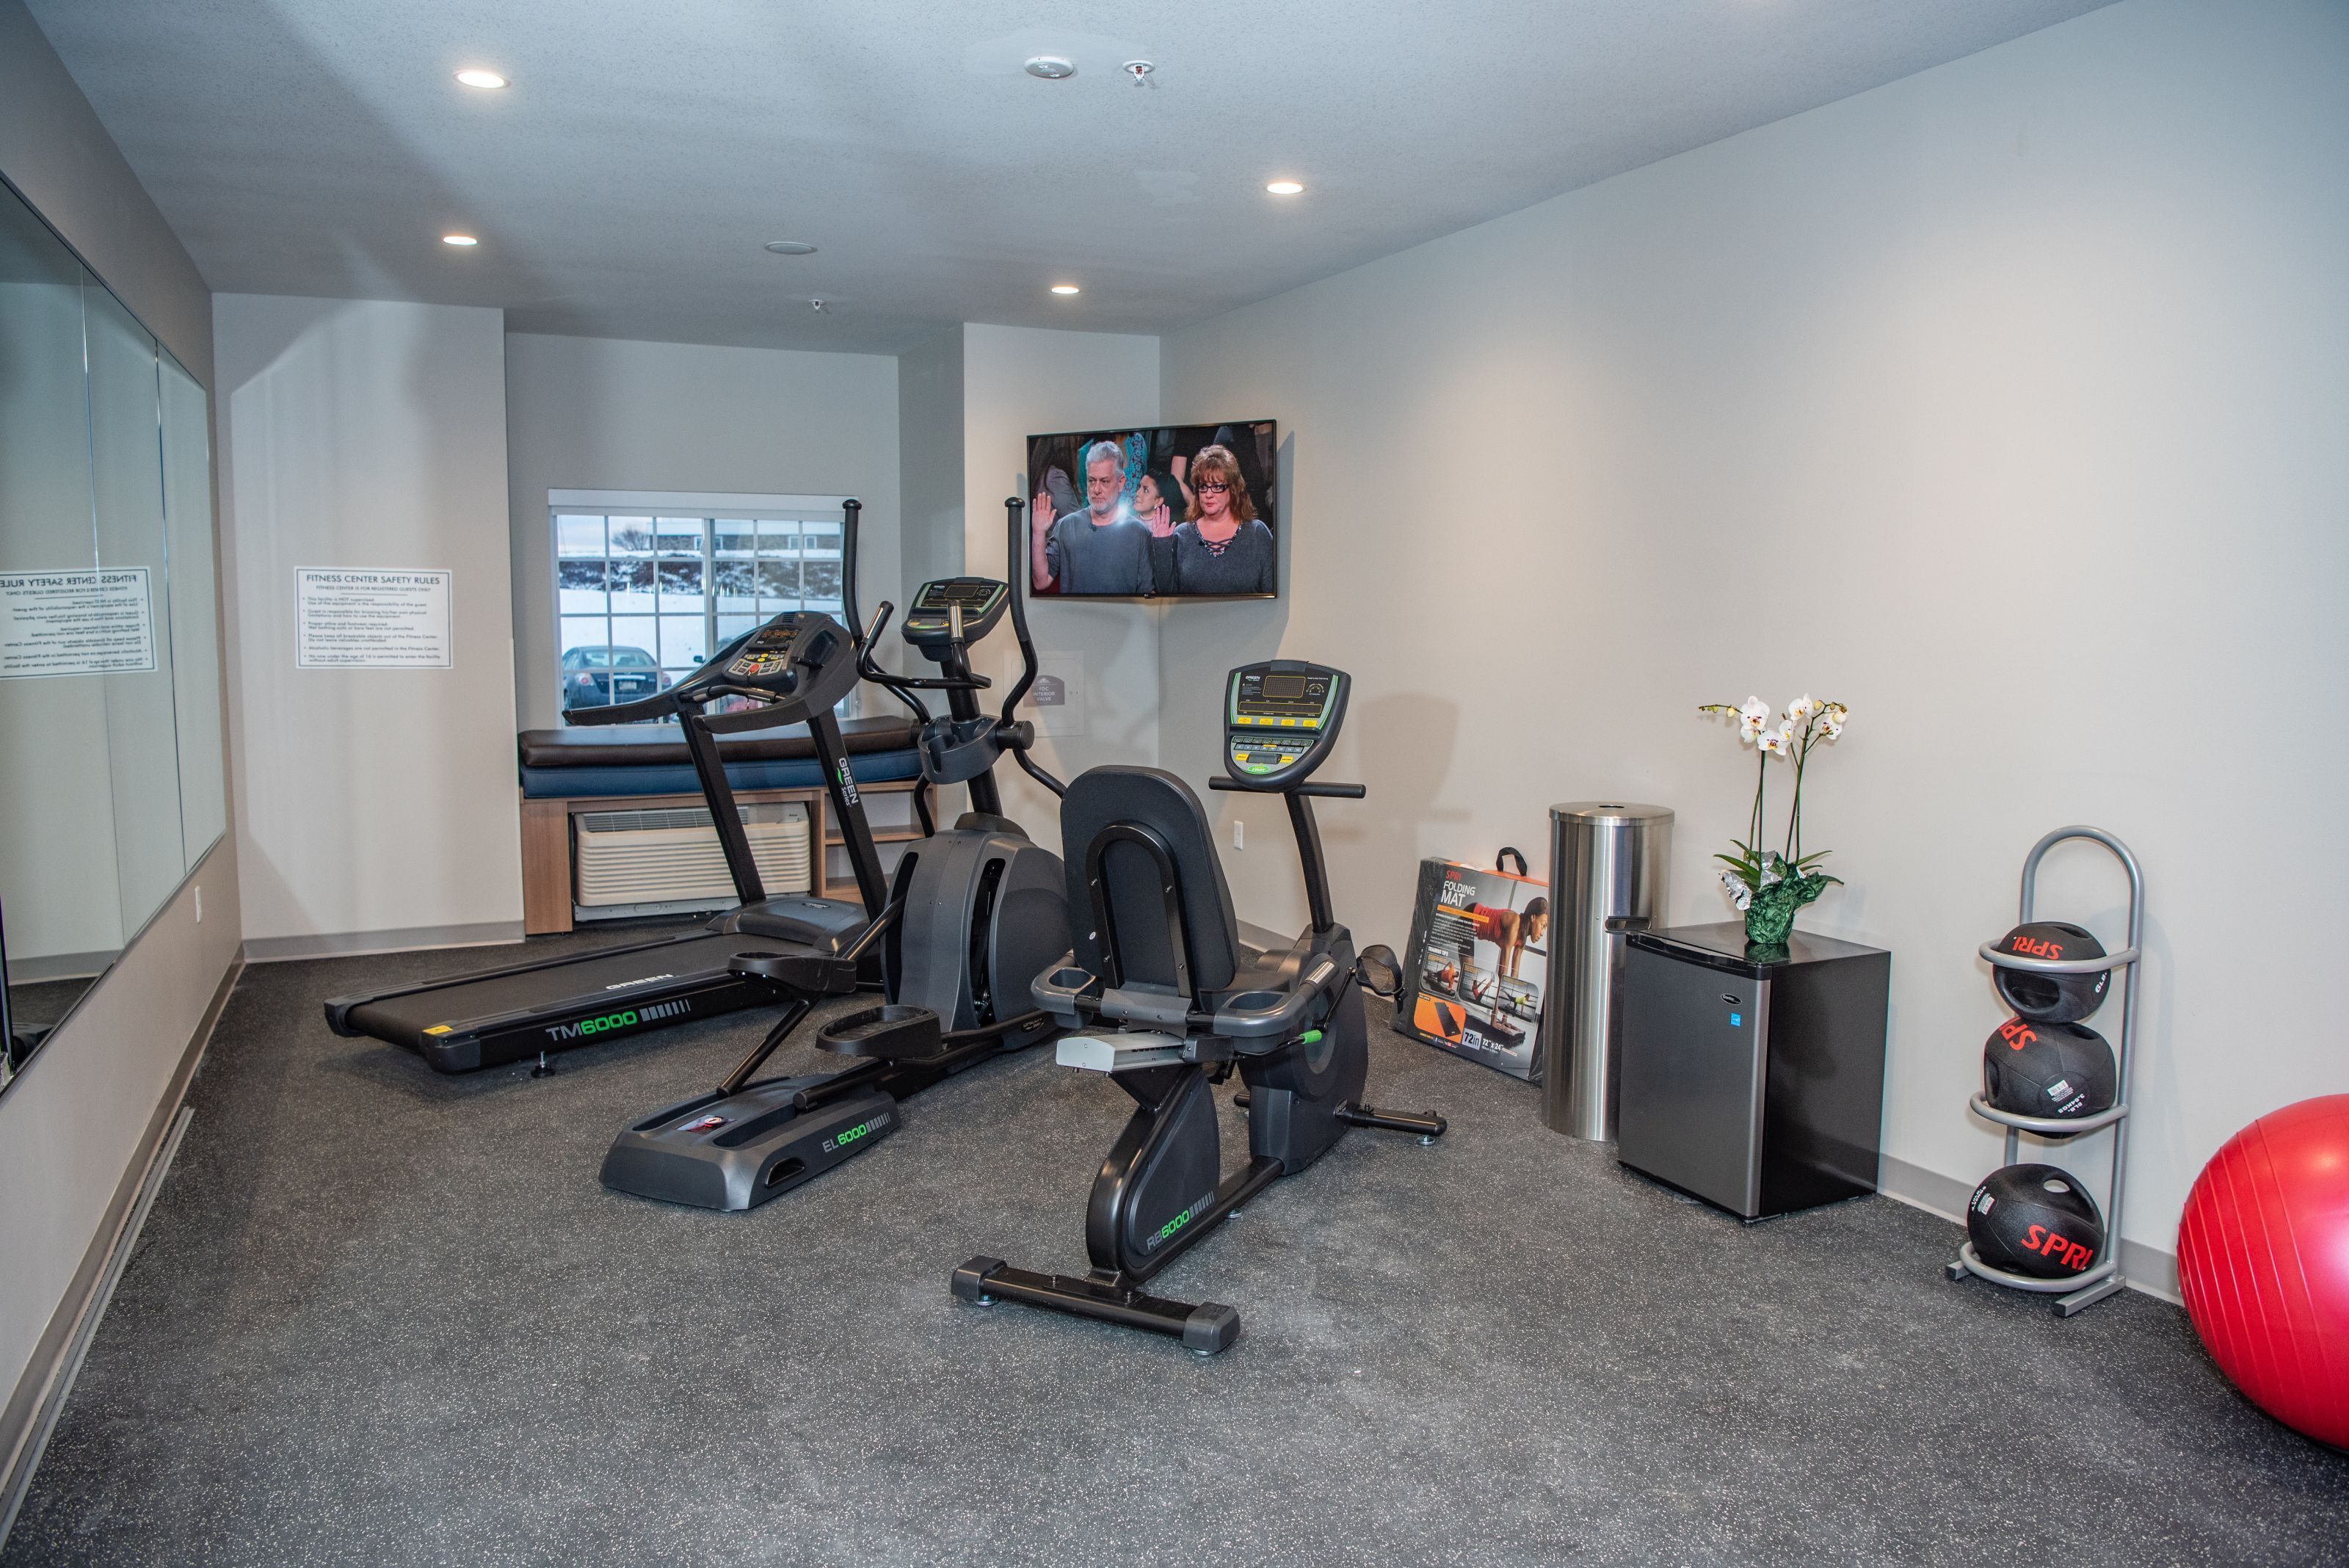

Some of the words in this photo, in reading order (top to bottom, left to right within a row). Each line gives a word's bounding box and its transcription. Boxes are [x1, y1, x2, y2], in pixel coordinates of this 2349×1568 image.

[839, 757, 858, 804] GREEN
[1446, 870, 1461, 881] SPRI
[1441, 890, 1465, 907] MAT
[1444, 881, 1476, 896] FOLDING
[2012, 936, 2063, 960] SPRI
[606, 974, 673, 990] GREEN
[546, 1011, 637, 1041] TM6000
[2000, 1017, 2036, 1050] SP
[1465, 1033, 1479, 1047] 72in
[1146, 1210, 1190, 1251] RB6000
[2021, 1225, 2094, 1271] SPRI
